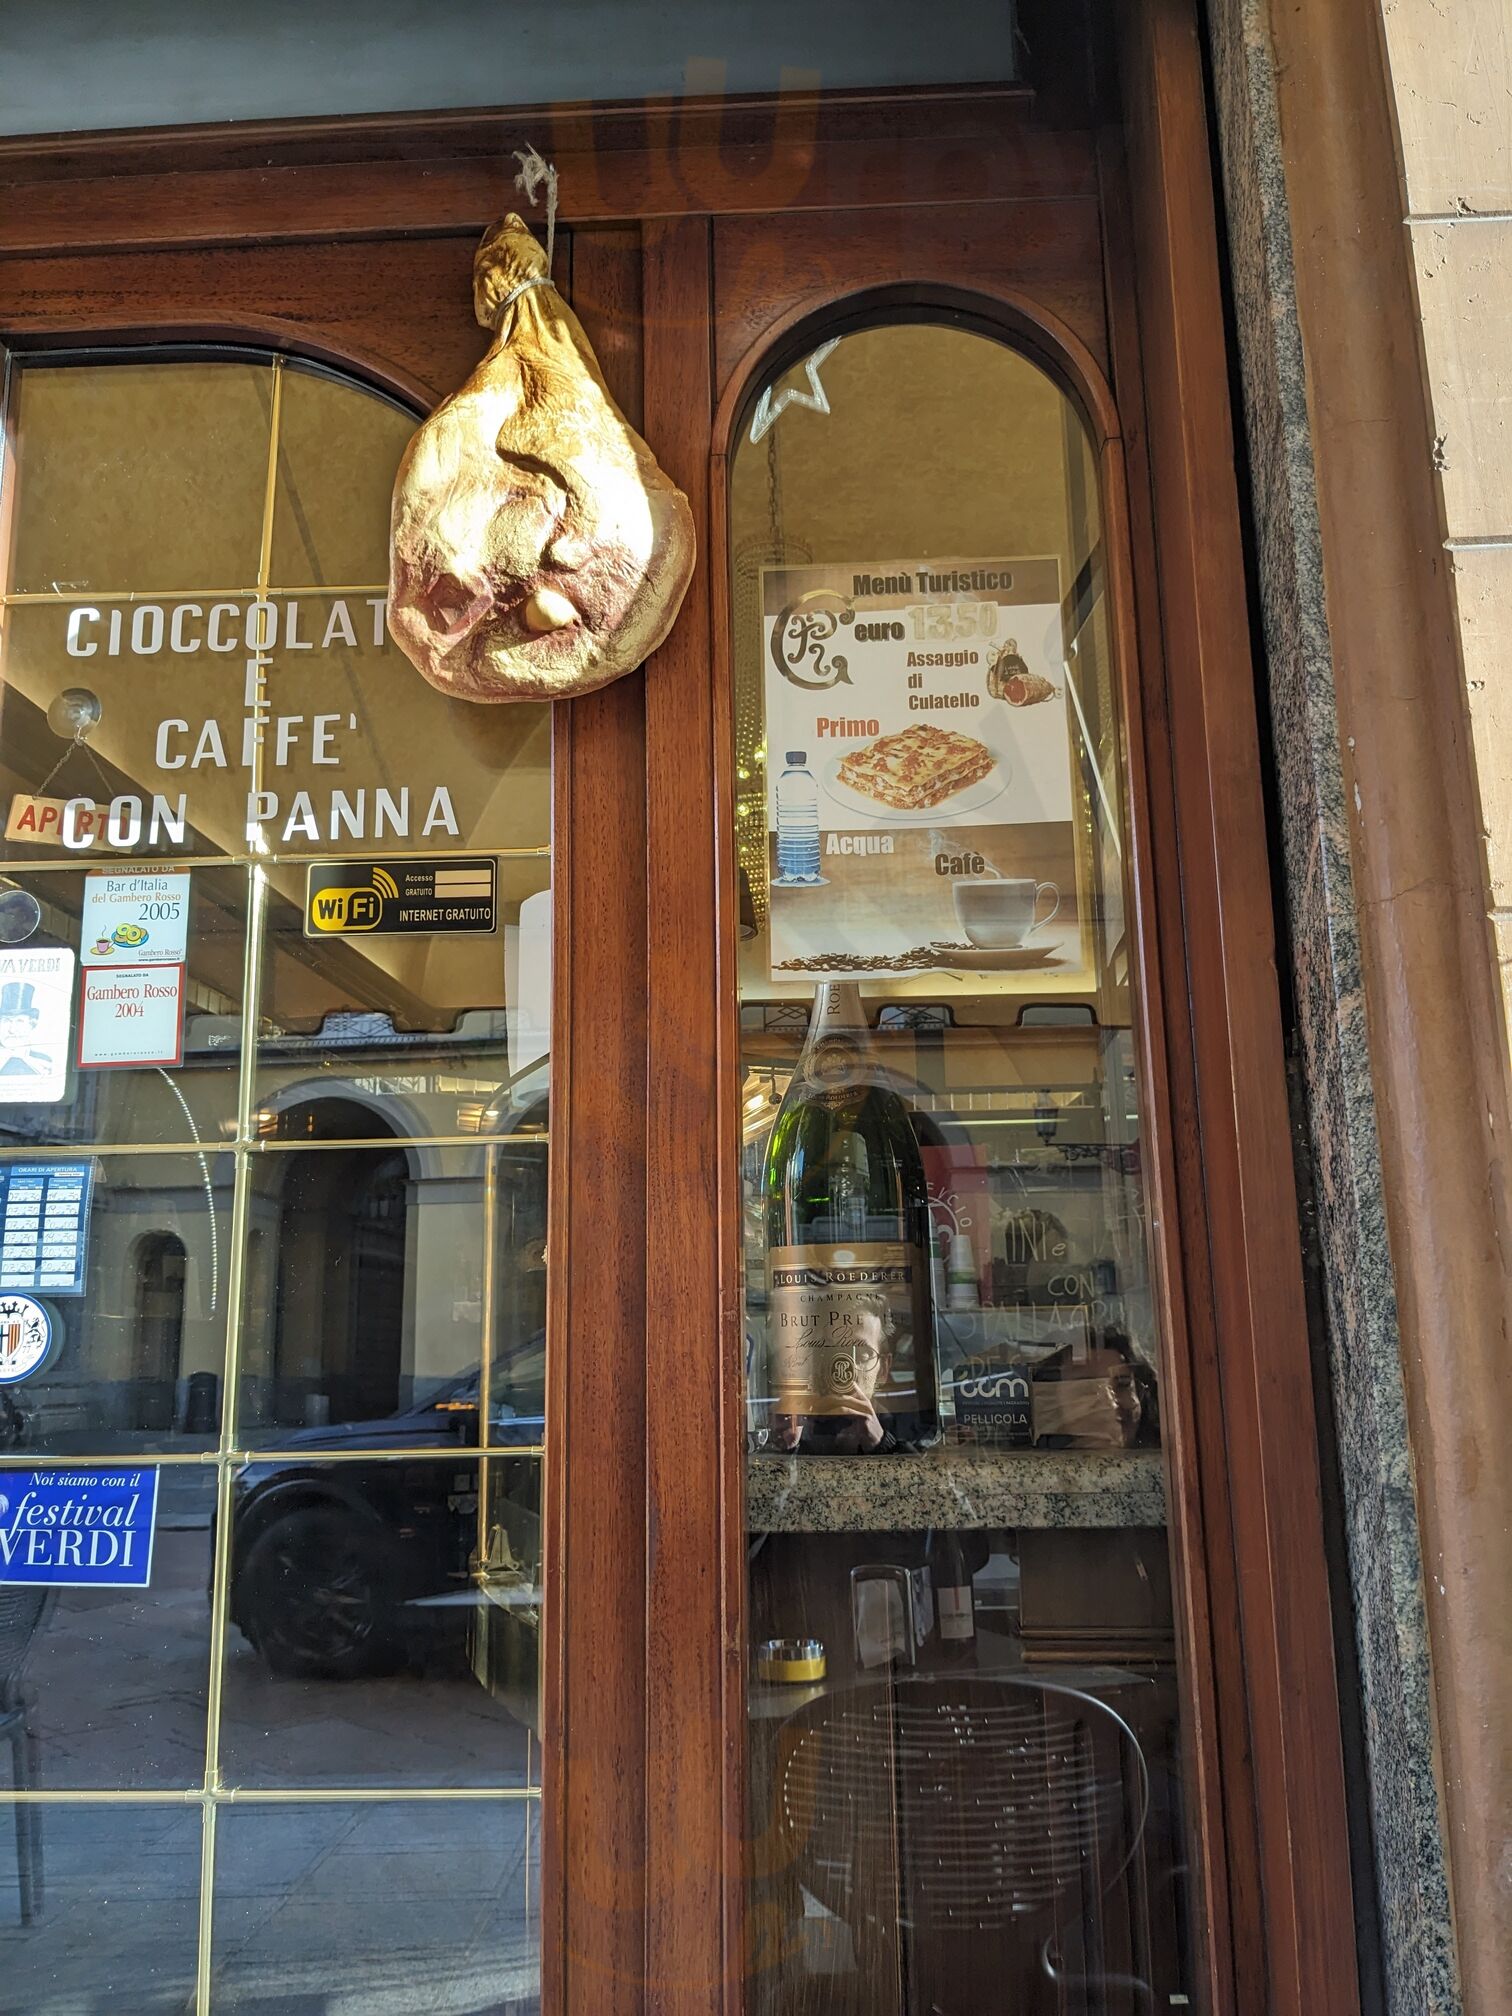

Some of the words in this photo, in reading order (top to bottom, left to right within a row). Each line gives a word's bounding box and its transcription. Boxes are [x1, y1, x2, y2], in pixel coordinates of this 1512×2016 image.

[853, 572, 912, 596] Menù
[915, 570, 1013, 593] Turistico
[854, 621, 905, 642] euro
[906, 650, 979, 667] Assaggio
[244, 657, 273, 707] E
[907, 673, 923, 689] di
[908, 692, 980, 710] Culatello
[816, 716, 880, 738] Primo
[155, 713, 357, 769] CAFFE'
[16, 804, 128, 842] APRT
[62, 794, 187, 849] CON
[245, 786, 459, 842] PANNA
[825, 833, 894, 857] Acqua
[934, 851, 985, 876] Cafè
[106, 880, 126, 892] Bar
[129, 878, 168, 891] d'Italia
[405, 874, 433, 882] Accesso
[92, 893, 106, 903] del
[109, 892, 152, 903] Gambero
[155, 891, 181, 901] Rosso
[405, 888, 433, 897] GRATUITO
[138, 902, 181, 921] 2005
[399, 909, 444, 922] INTERNET
[445, 908, 491, 920] GRATUITO
[87, 984, 139, 1001] Gambero
[143, 983, 178, 998] Rosso
[115, 1001, 144, 1018] 2004
[825, 1270, 905, 1283] ROEDERER
[1047, 1271, 1096, 1299] CON
[780, 1312, 820, 1328] BRUT
[963, 1413, 1029, 1425] PELLICOLA
[29, 1472, 55, 1486] Noi
[57, 1473, 98, 1487] siamo
[101, 1476, 126, 1487] con
[129, 1473, 141, 1487] il
[8, 1491, 140, 1541] festival
[0, 1528, 137, 1567] VERDI
